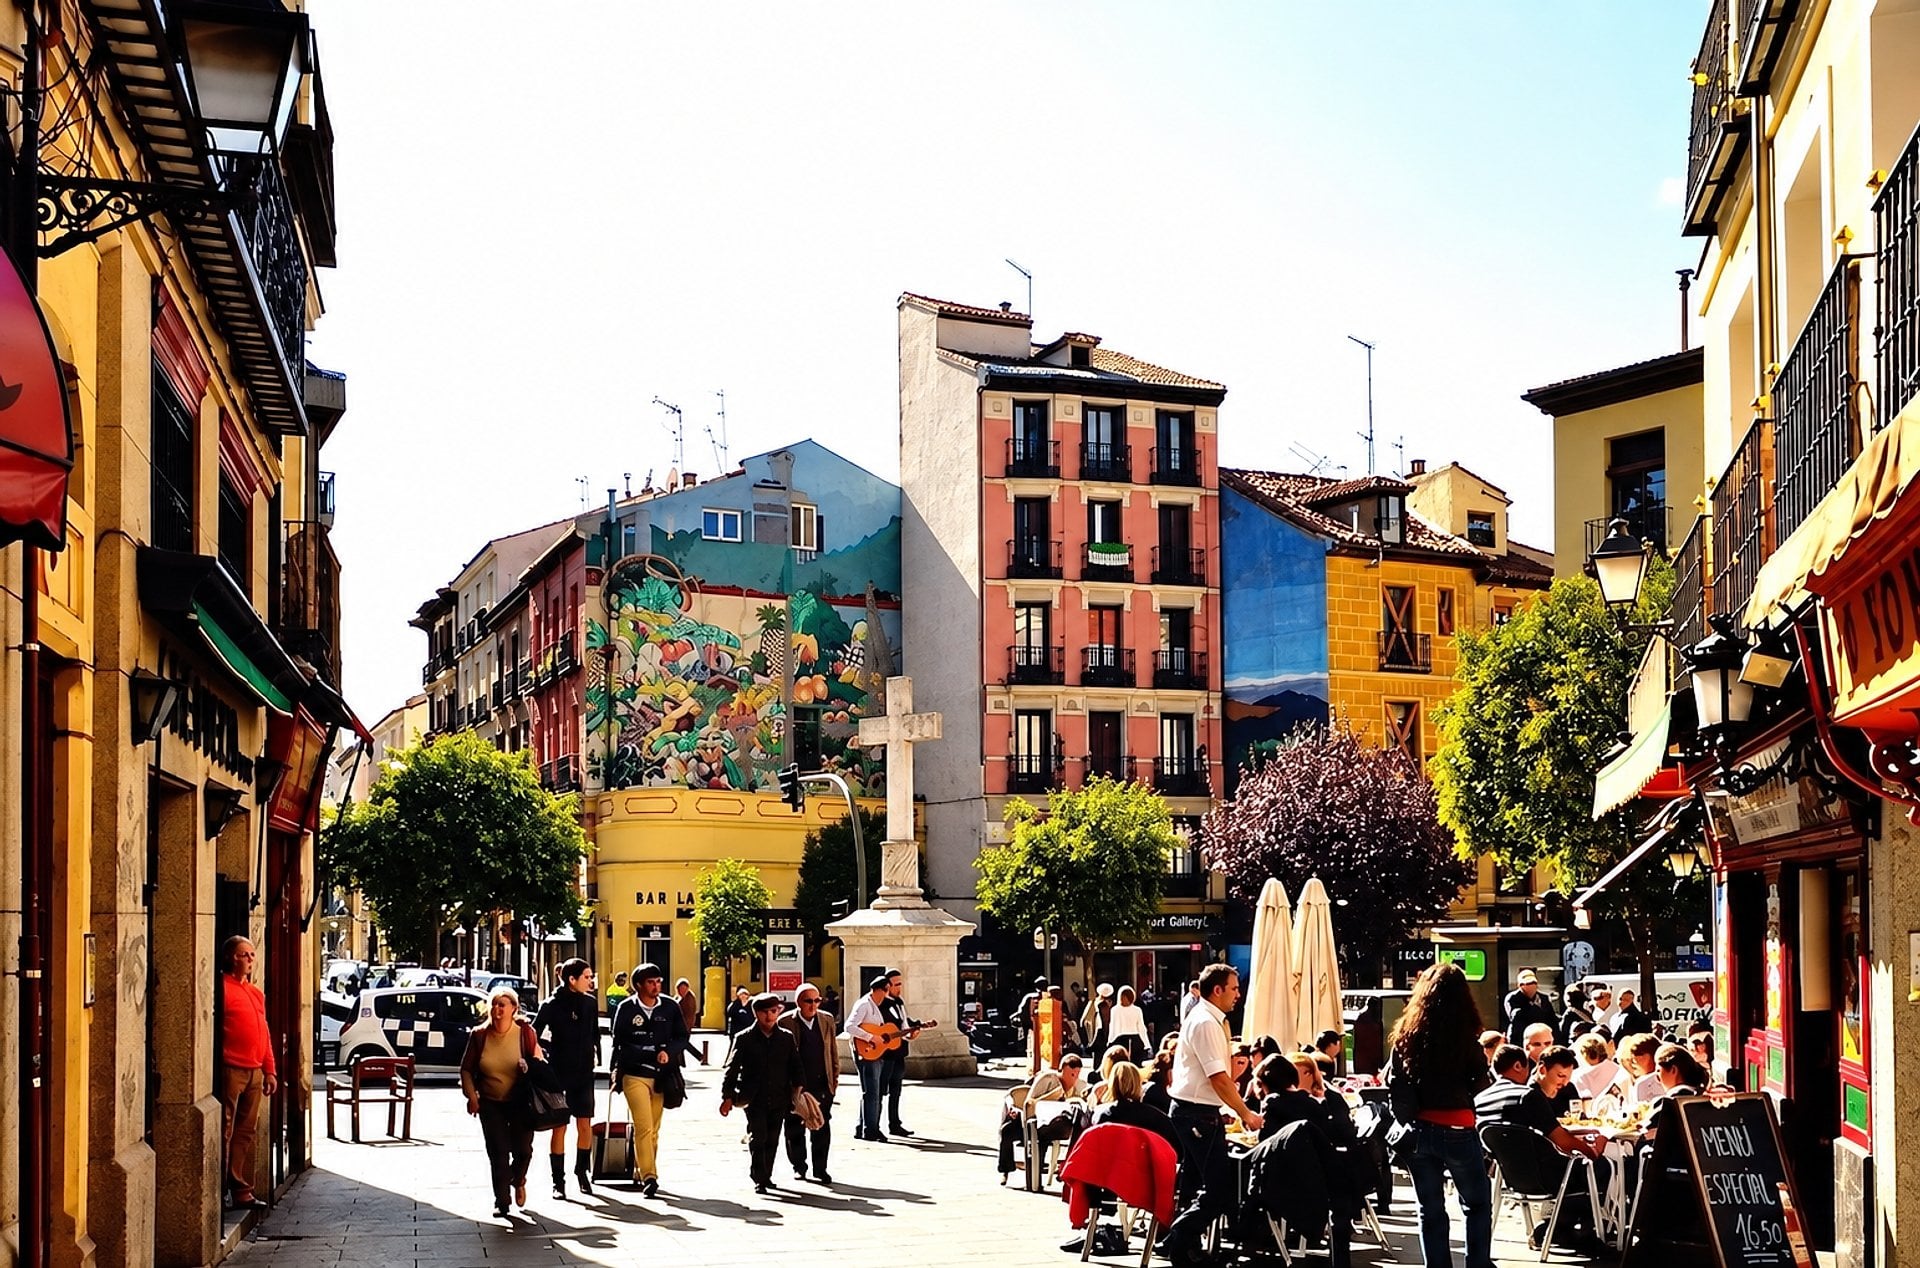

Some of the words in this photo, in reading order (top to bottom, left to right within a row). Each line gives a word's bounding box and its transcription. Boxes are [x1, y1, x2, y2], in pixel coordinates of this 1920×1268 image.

[635, 892, 668, 905] BAR
[1169, 915, 1203, 930] Gallery
[1703, 1167, 1776, 1206] ESPECIAL
